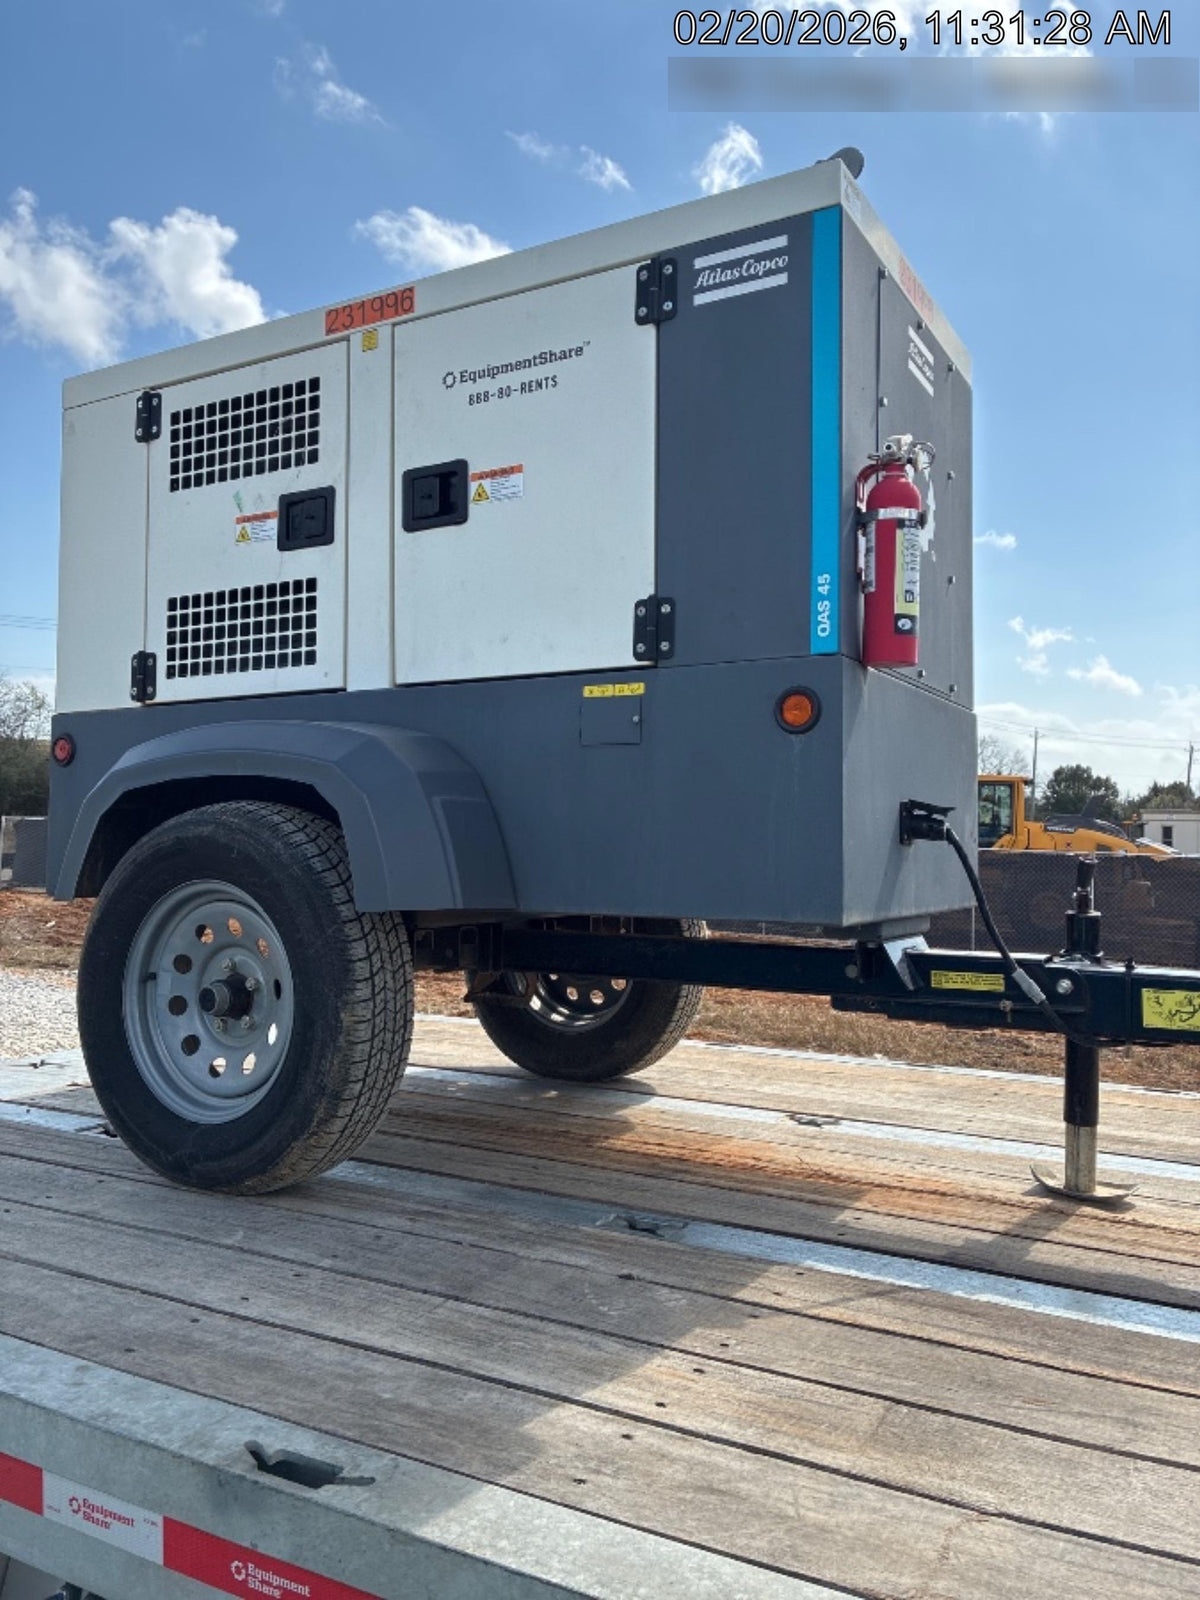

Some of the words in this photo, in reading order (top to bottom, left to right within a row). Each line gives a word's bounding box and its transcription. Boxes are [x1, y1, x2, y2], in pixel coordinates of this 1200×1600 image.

[693, 267, 741, 289] Atlas
[741, 255, 789, 276] Copco
[326, 287, 414, 336] 231996
[468, 374, 559, 406] 888-80-RENTS
[817, 573, 831, 596] 45
[817, 600, 831, 638] QAS
[82, 1498, 135, 1528] Equipment
[82, 1511, 111, 1530] Share
[248, 1562, 311, 1597] Equipment
[248, 1577, 281, 1599] Share
